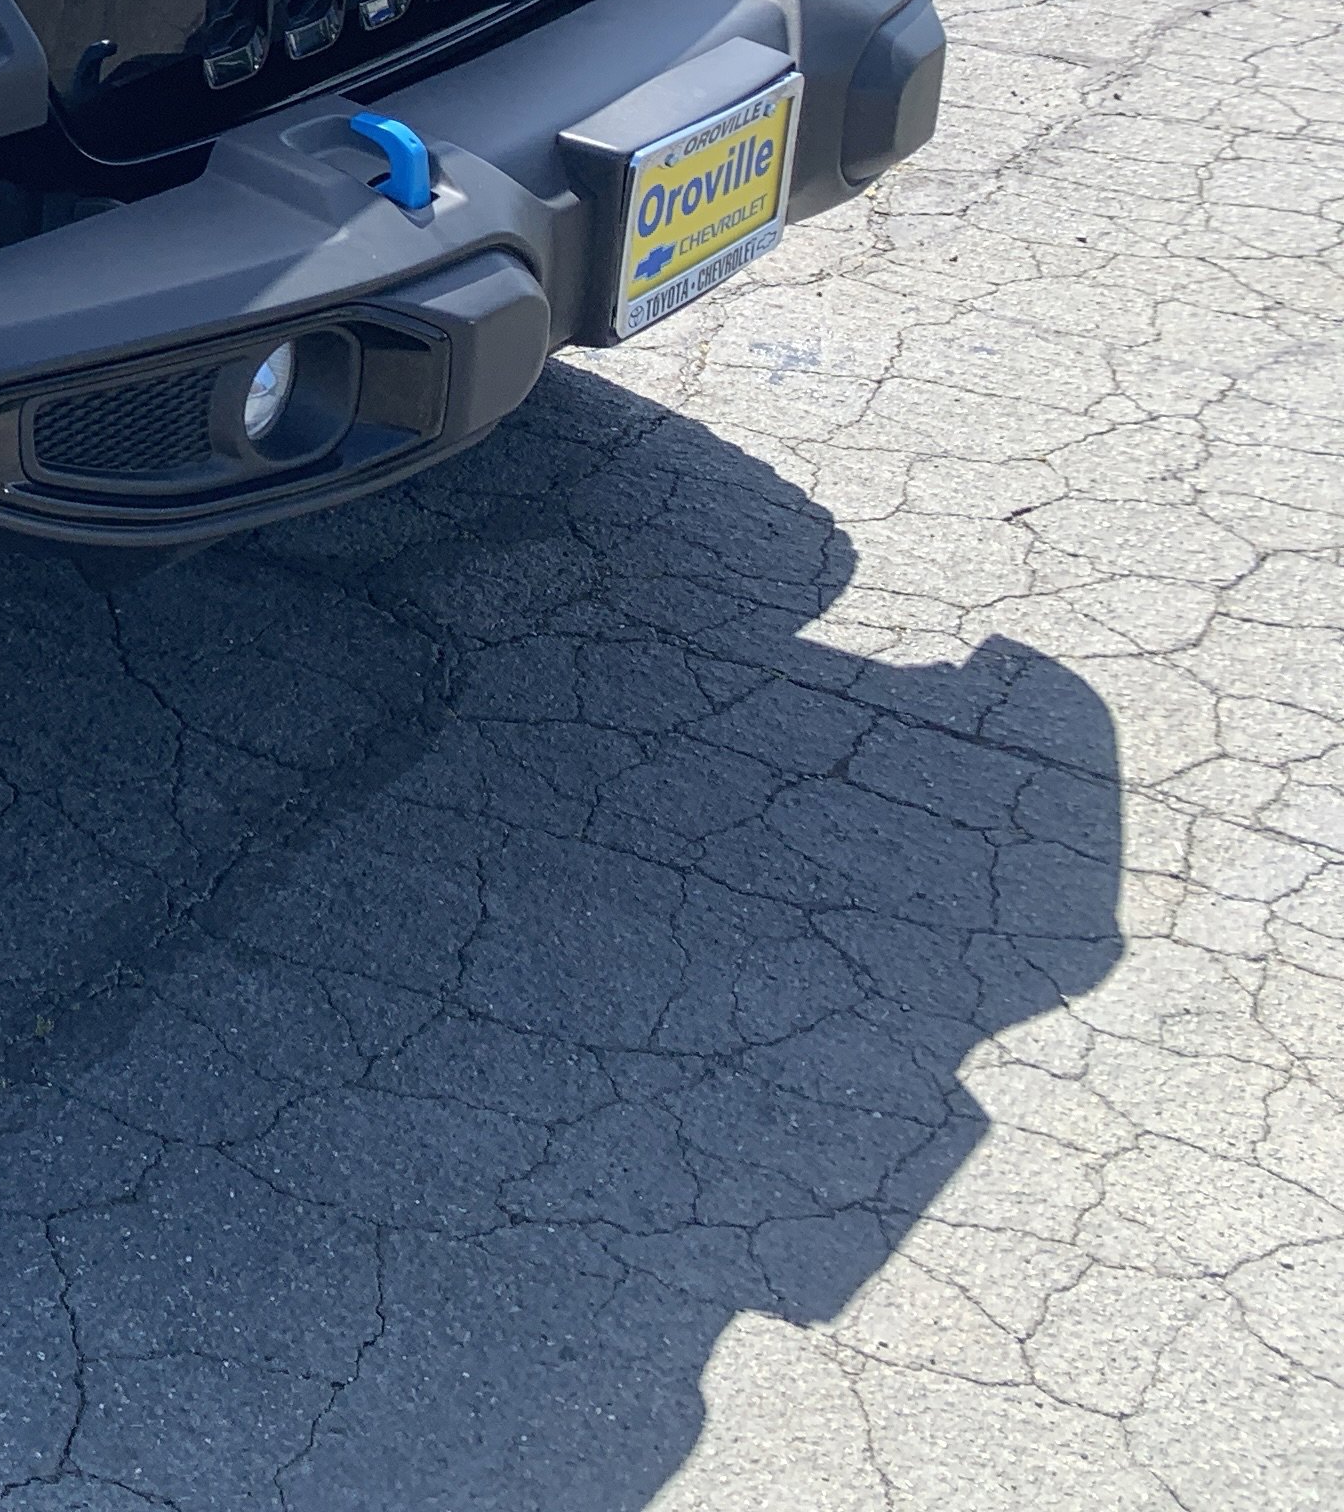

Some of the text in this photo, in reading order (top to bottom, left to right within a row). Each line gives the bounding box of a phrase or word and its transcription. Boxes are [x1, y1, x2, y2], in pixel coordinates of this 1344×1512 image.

[684, 100, 763, 155] OROVILLE
[637, 136, 774, 237] Oroville
[679, 193, 767, 256] CHEVROLET
[646, 237, 758, 322] TOYOTA CHEVROLET
